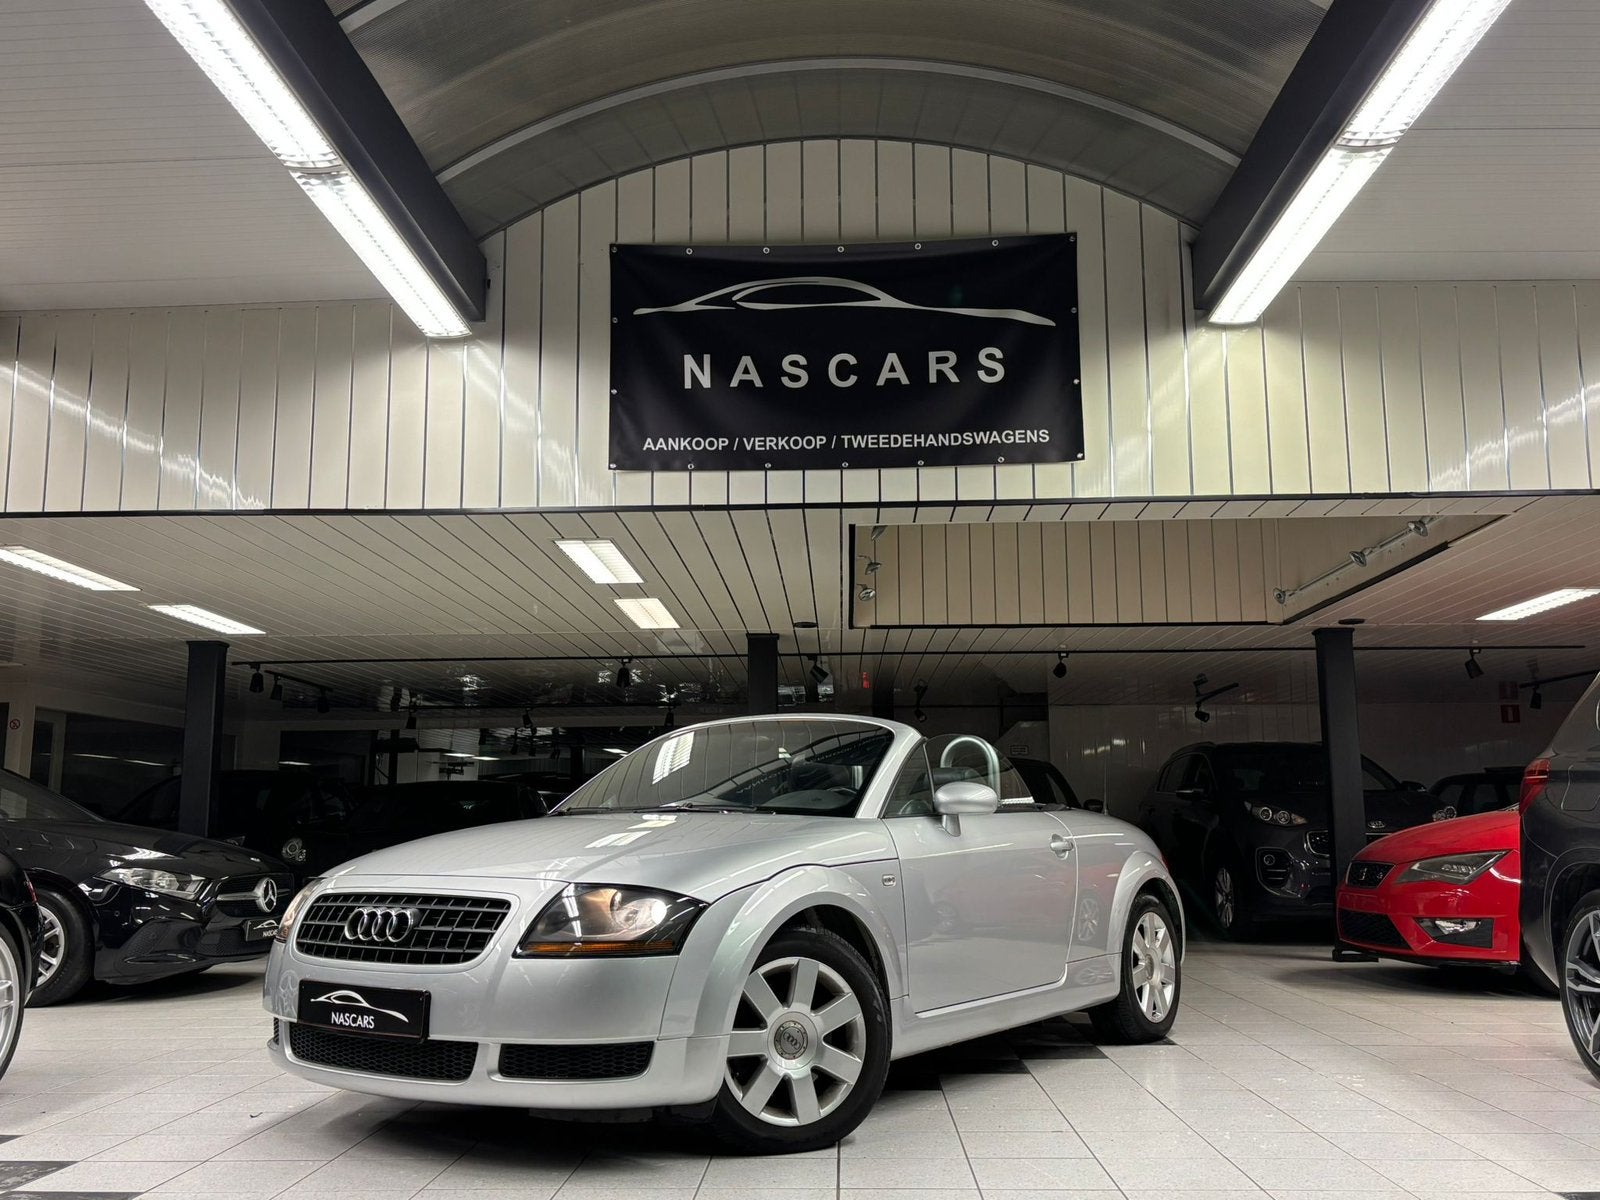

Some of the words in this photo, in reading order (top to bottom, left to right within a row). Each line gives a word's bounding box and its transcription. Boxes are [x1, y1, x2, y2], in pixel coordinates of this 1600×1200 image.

[683, 347, 1005, 389] NASCARS
[642, 437, 729, 451] AANKOOP
[743, 435, 827, 451] VERKOOP
[840, 429, 1050, 449] TWEEDEHANDSWAGENS
[331, 1010, 375, 1029] NASCARS
